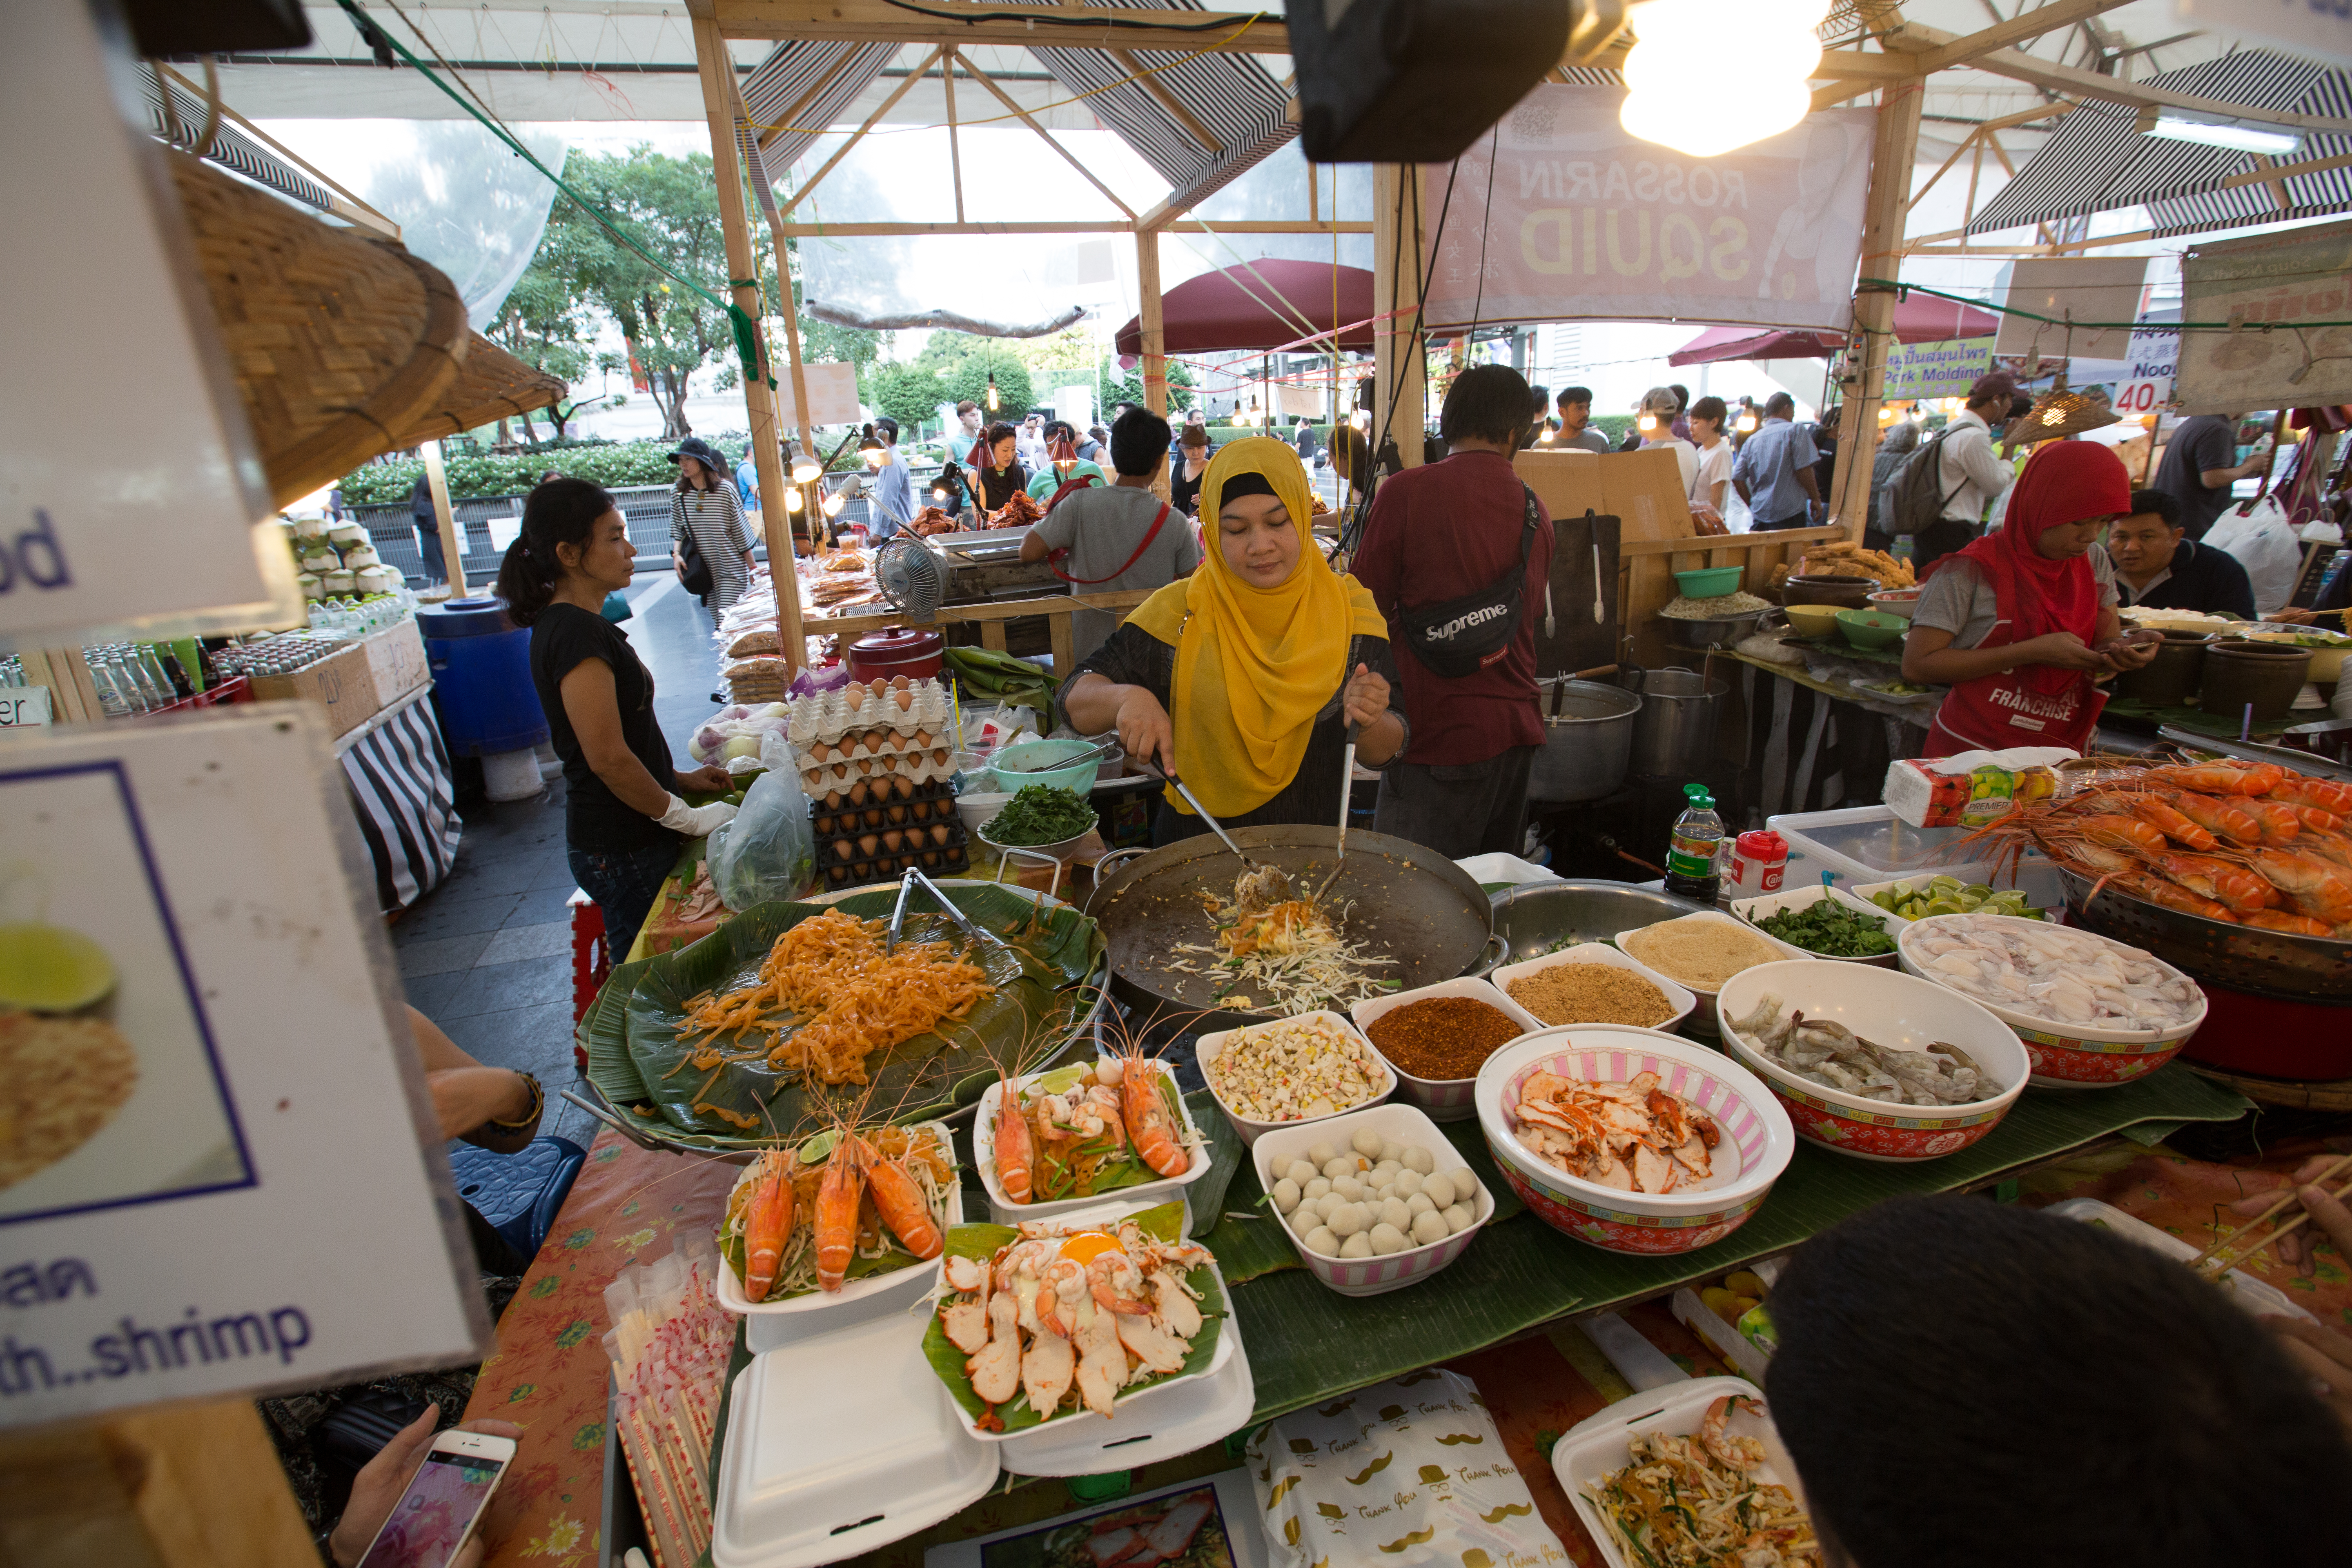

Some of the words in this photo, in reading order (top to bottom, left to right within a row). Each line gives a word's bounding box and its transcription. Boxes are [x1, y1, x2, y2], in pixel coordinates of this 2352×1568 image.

[1426, 604, 1508, 641] Supreme
[1482, 648, 1506, 665] Supreme
[1988, 688, 2072, 722] FRANCHISE
[634, 1423, 651, 1461] CHOPSTICKS
